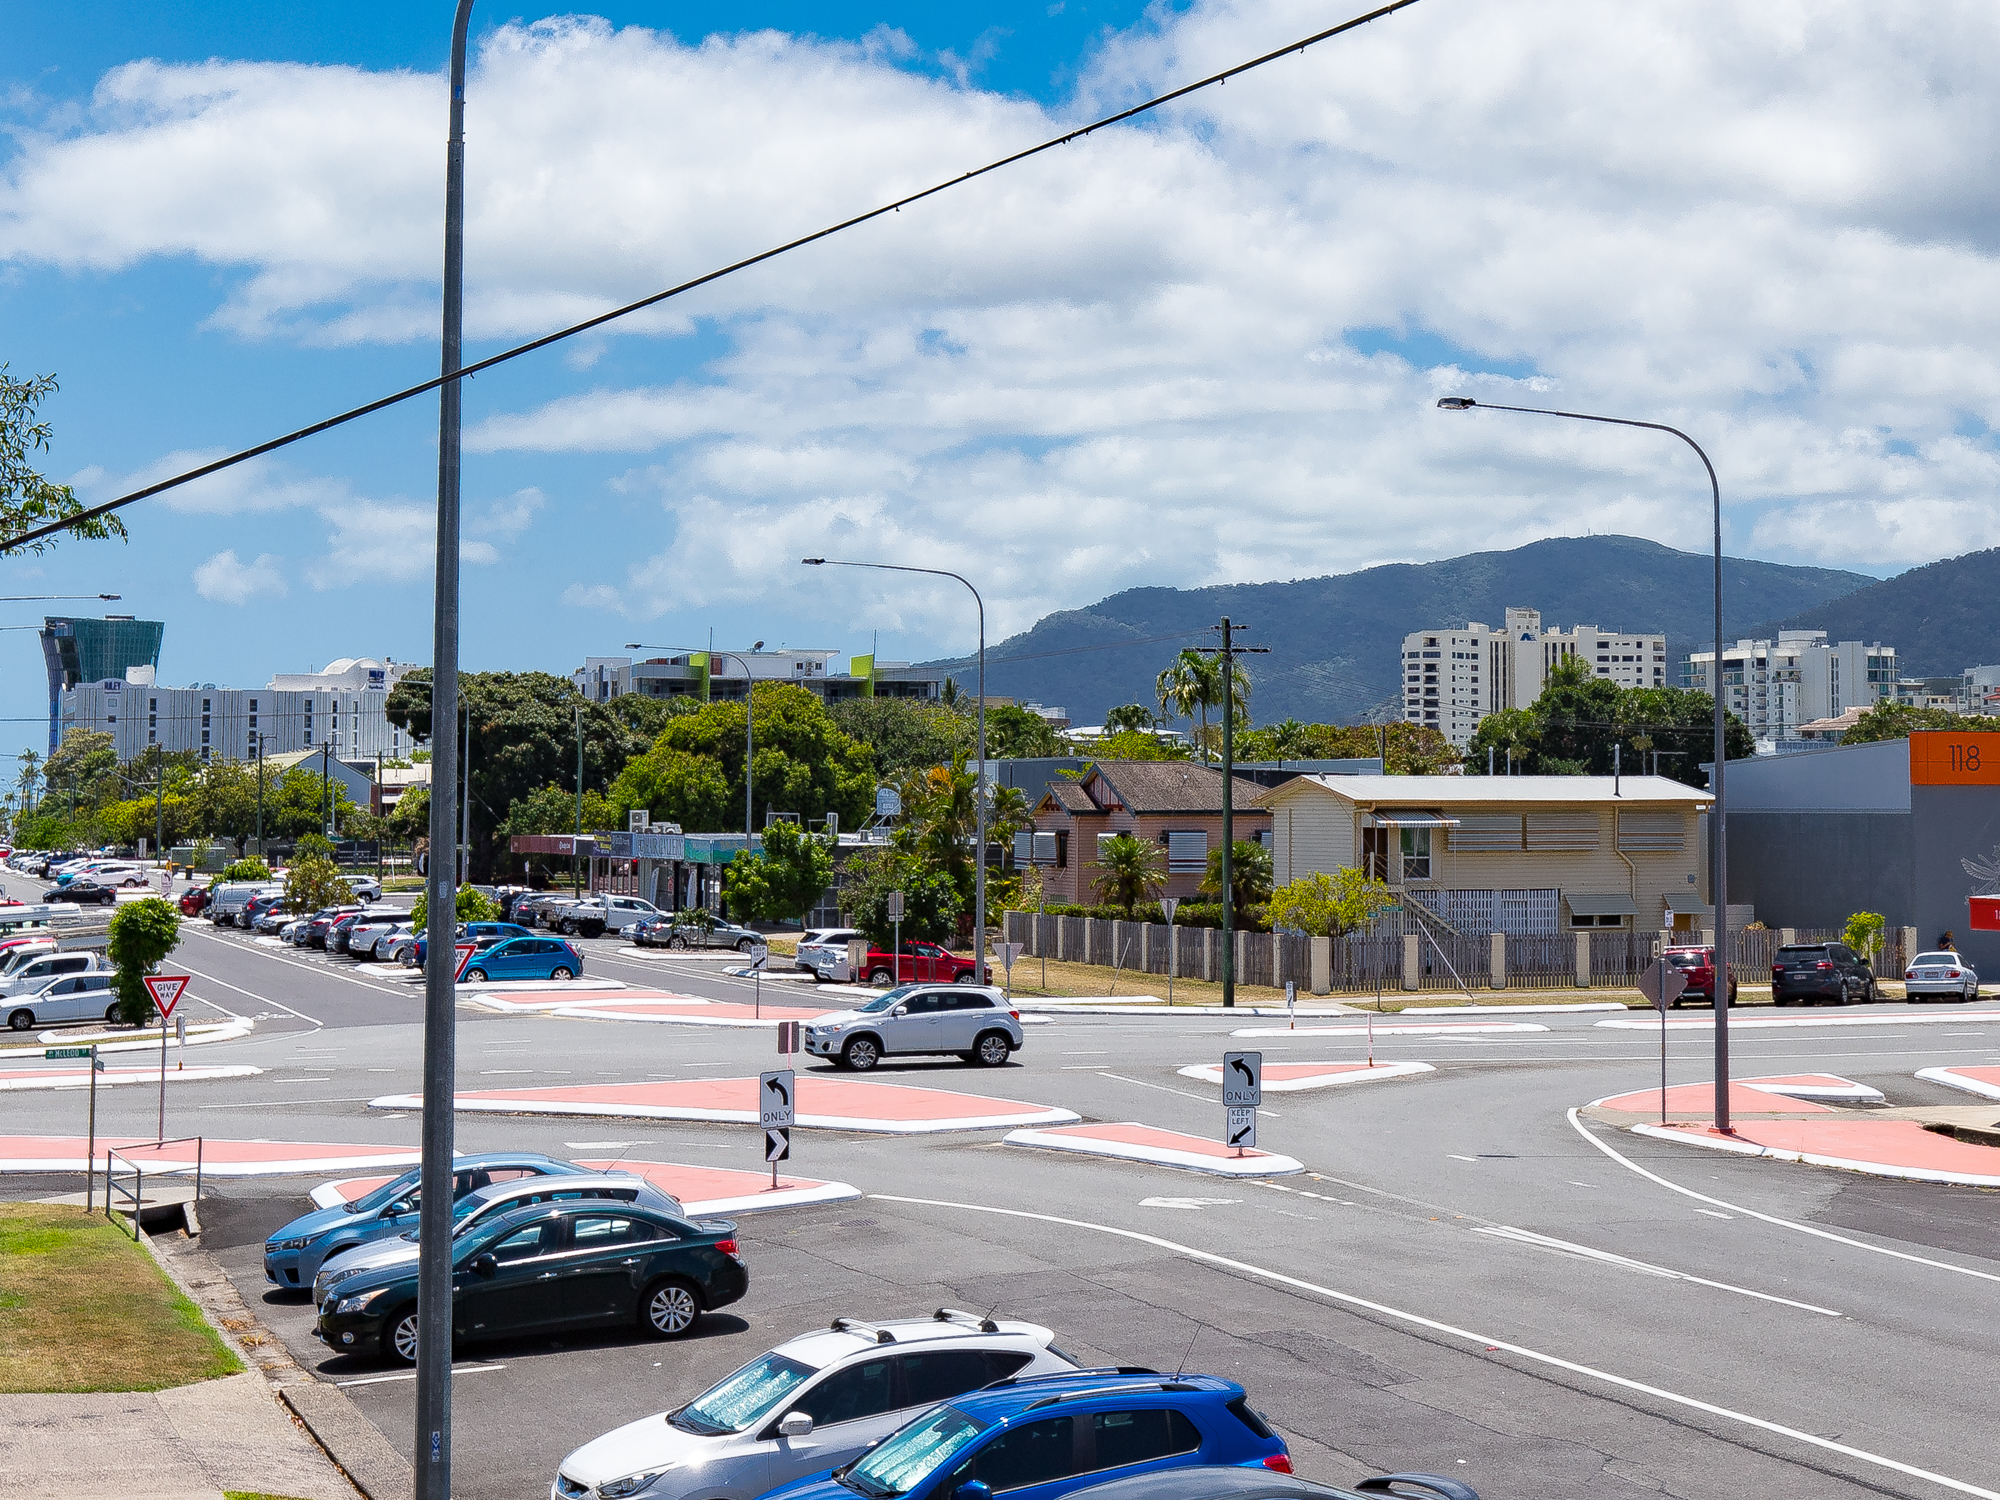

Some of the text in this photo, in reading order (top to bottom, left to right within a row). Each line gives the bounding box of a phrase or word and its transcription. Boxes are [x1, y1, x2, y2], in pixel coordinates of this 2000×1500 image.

[1949, 744, 1981, 772] 118
[157, 983, 178, 991] GIVE
[1226, 1091, 1258, 1101] ONLY
[763, 1109, 791, 1123] ONLY
[1231, 1109, 1251, 1117] KEEP
